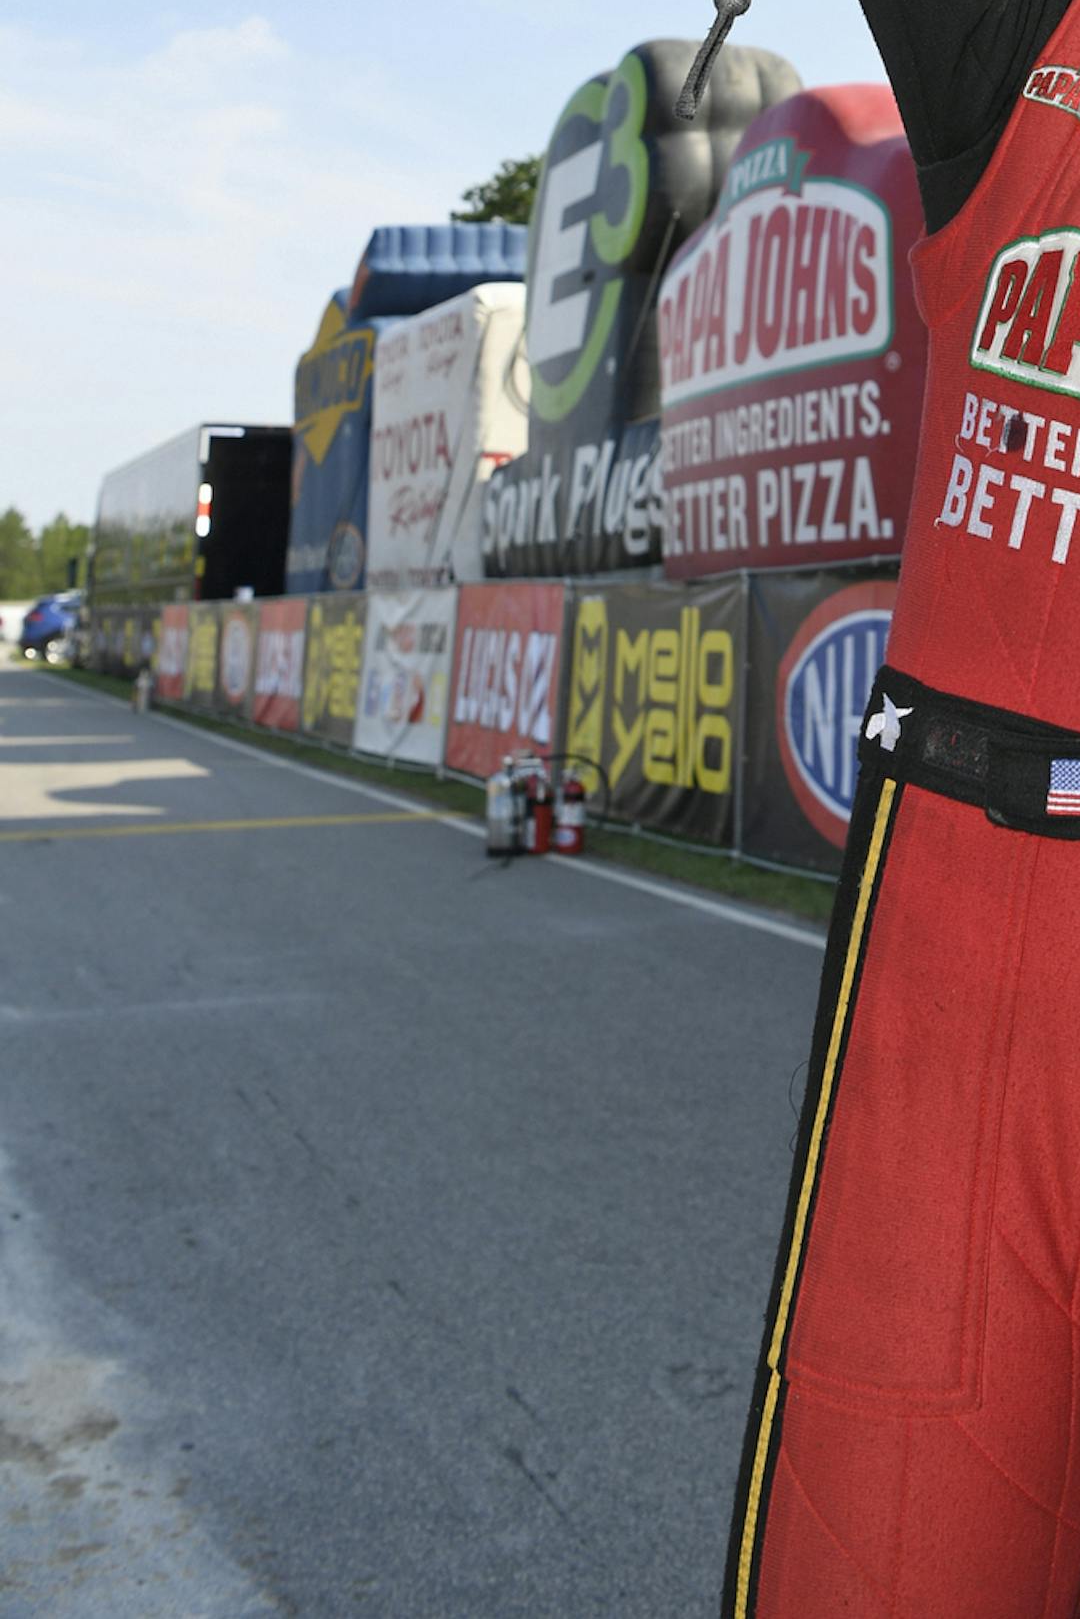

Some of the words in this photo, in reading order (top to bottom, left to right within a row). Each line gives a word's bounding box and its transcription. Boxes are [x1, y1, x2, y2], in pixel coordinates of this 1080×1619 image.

[731, 141, 788, 199] PIZZA
[660, 230, 732, 385] PAPA
[715, 379, 891, 461] INGREDIENTS.
[757, 456, 895, 548] PIZZA.
[613, 606, 734, 709] Mello
[608, 703, 733, 795] Yello
[803, 629, 878, 801] NH
